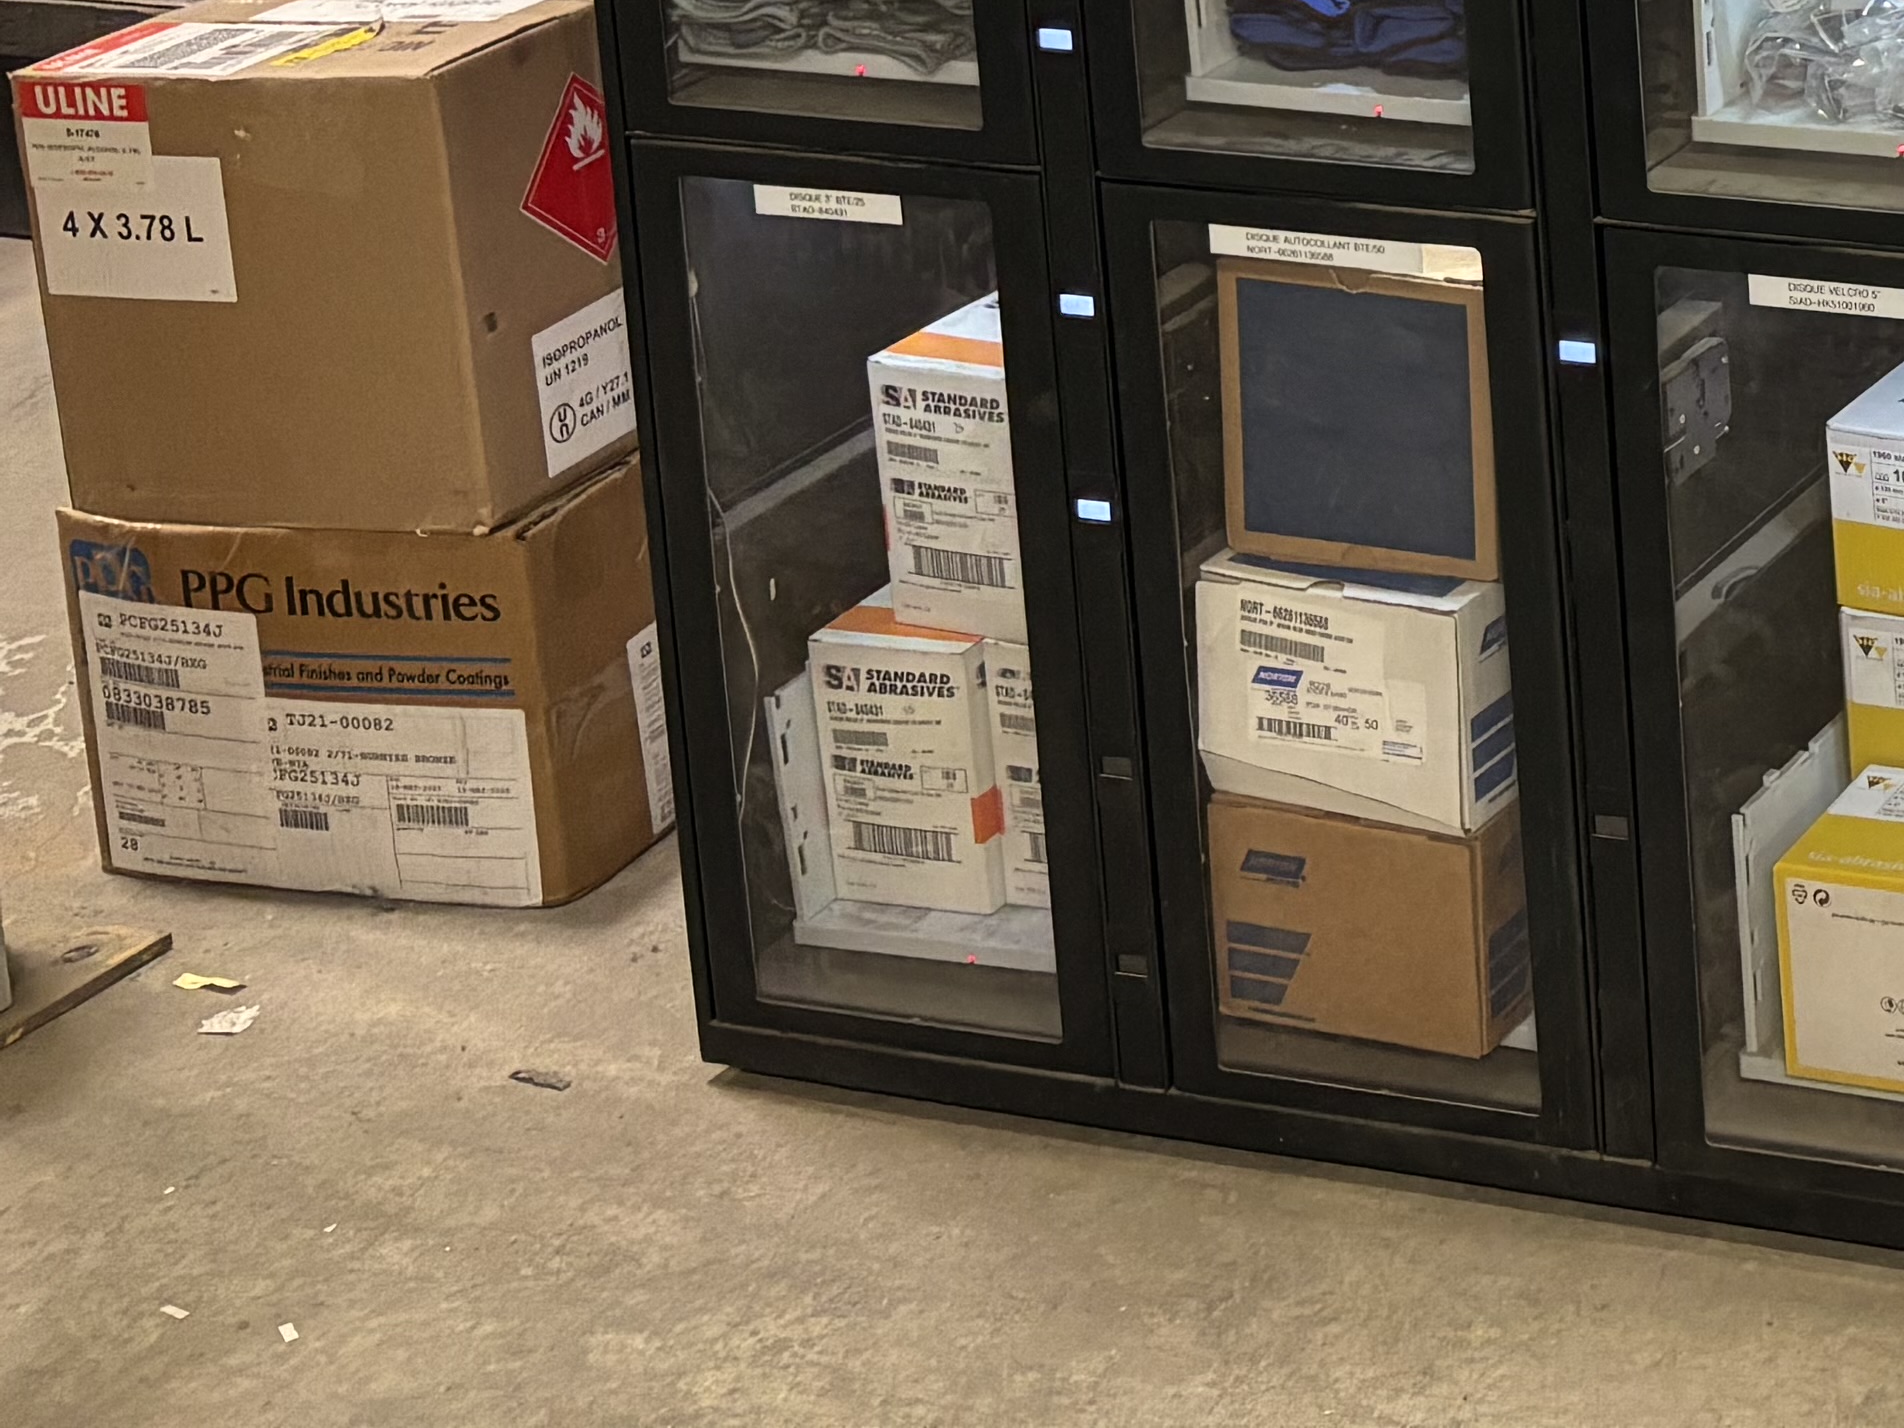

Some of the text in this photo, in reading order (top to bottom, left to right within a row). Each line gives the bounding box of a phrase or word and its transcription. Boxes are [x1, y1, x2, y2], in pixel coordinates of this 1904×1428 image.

[34, 85, 129, 118] ULINE
[62, 210, 204, 242] 4 X 3.78 L
[542, 315, 623, 369] ISOPROPANOL
[545, 353, 589, 387] UN 1219
[579, 391, 594, 408] 4G
[921, 390, 1001, 411] STANDARD
[581, 404, 604, 427] CAN
[923, 403, 1005, 424] ABRASIVES
[180, 569, 502, 623] PPG Industries
[299, 664, 353, 682] Finishes
[357, 667, 383, 685] and
[388, 667, 441, 686] Powder
[446, 670, 510, 690] Coatings
[865, 668, 951, 685] STANDARD
[867, 682, 956, 699] ABRASIVES
[286, 713, 394, 732] TJ21-00082
